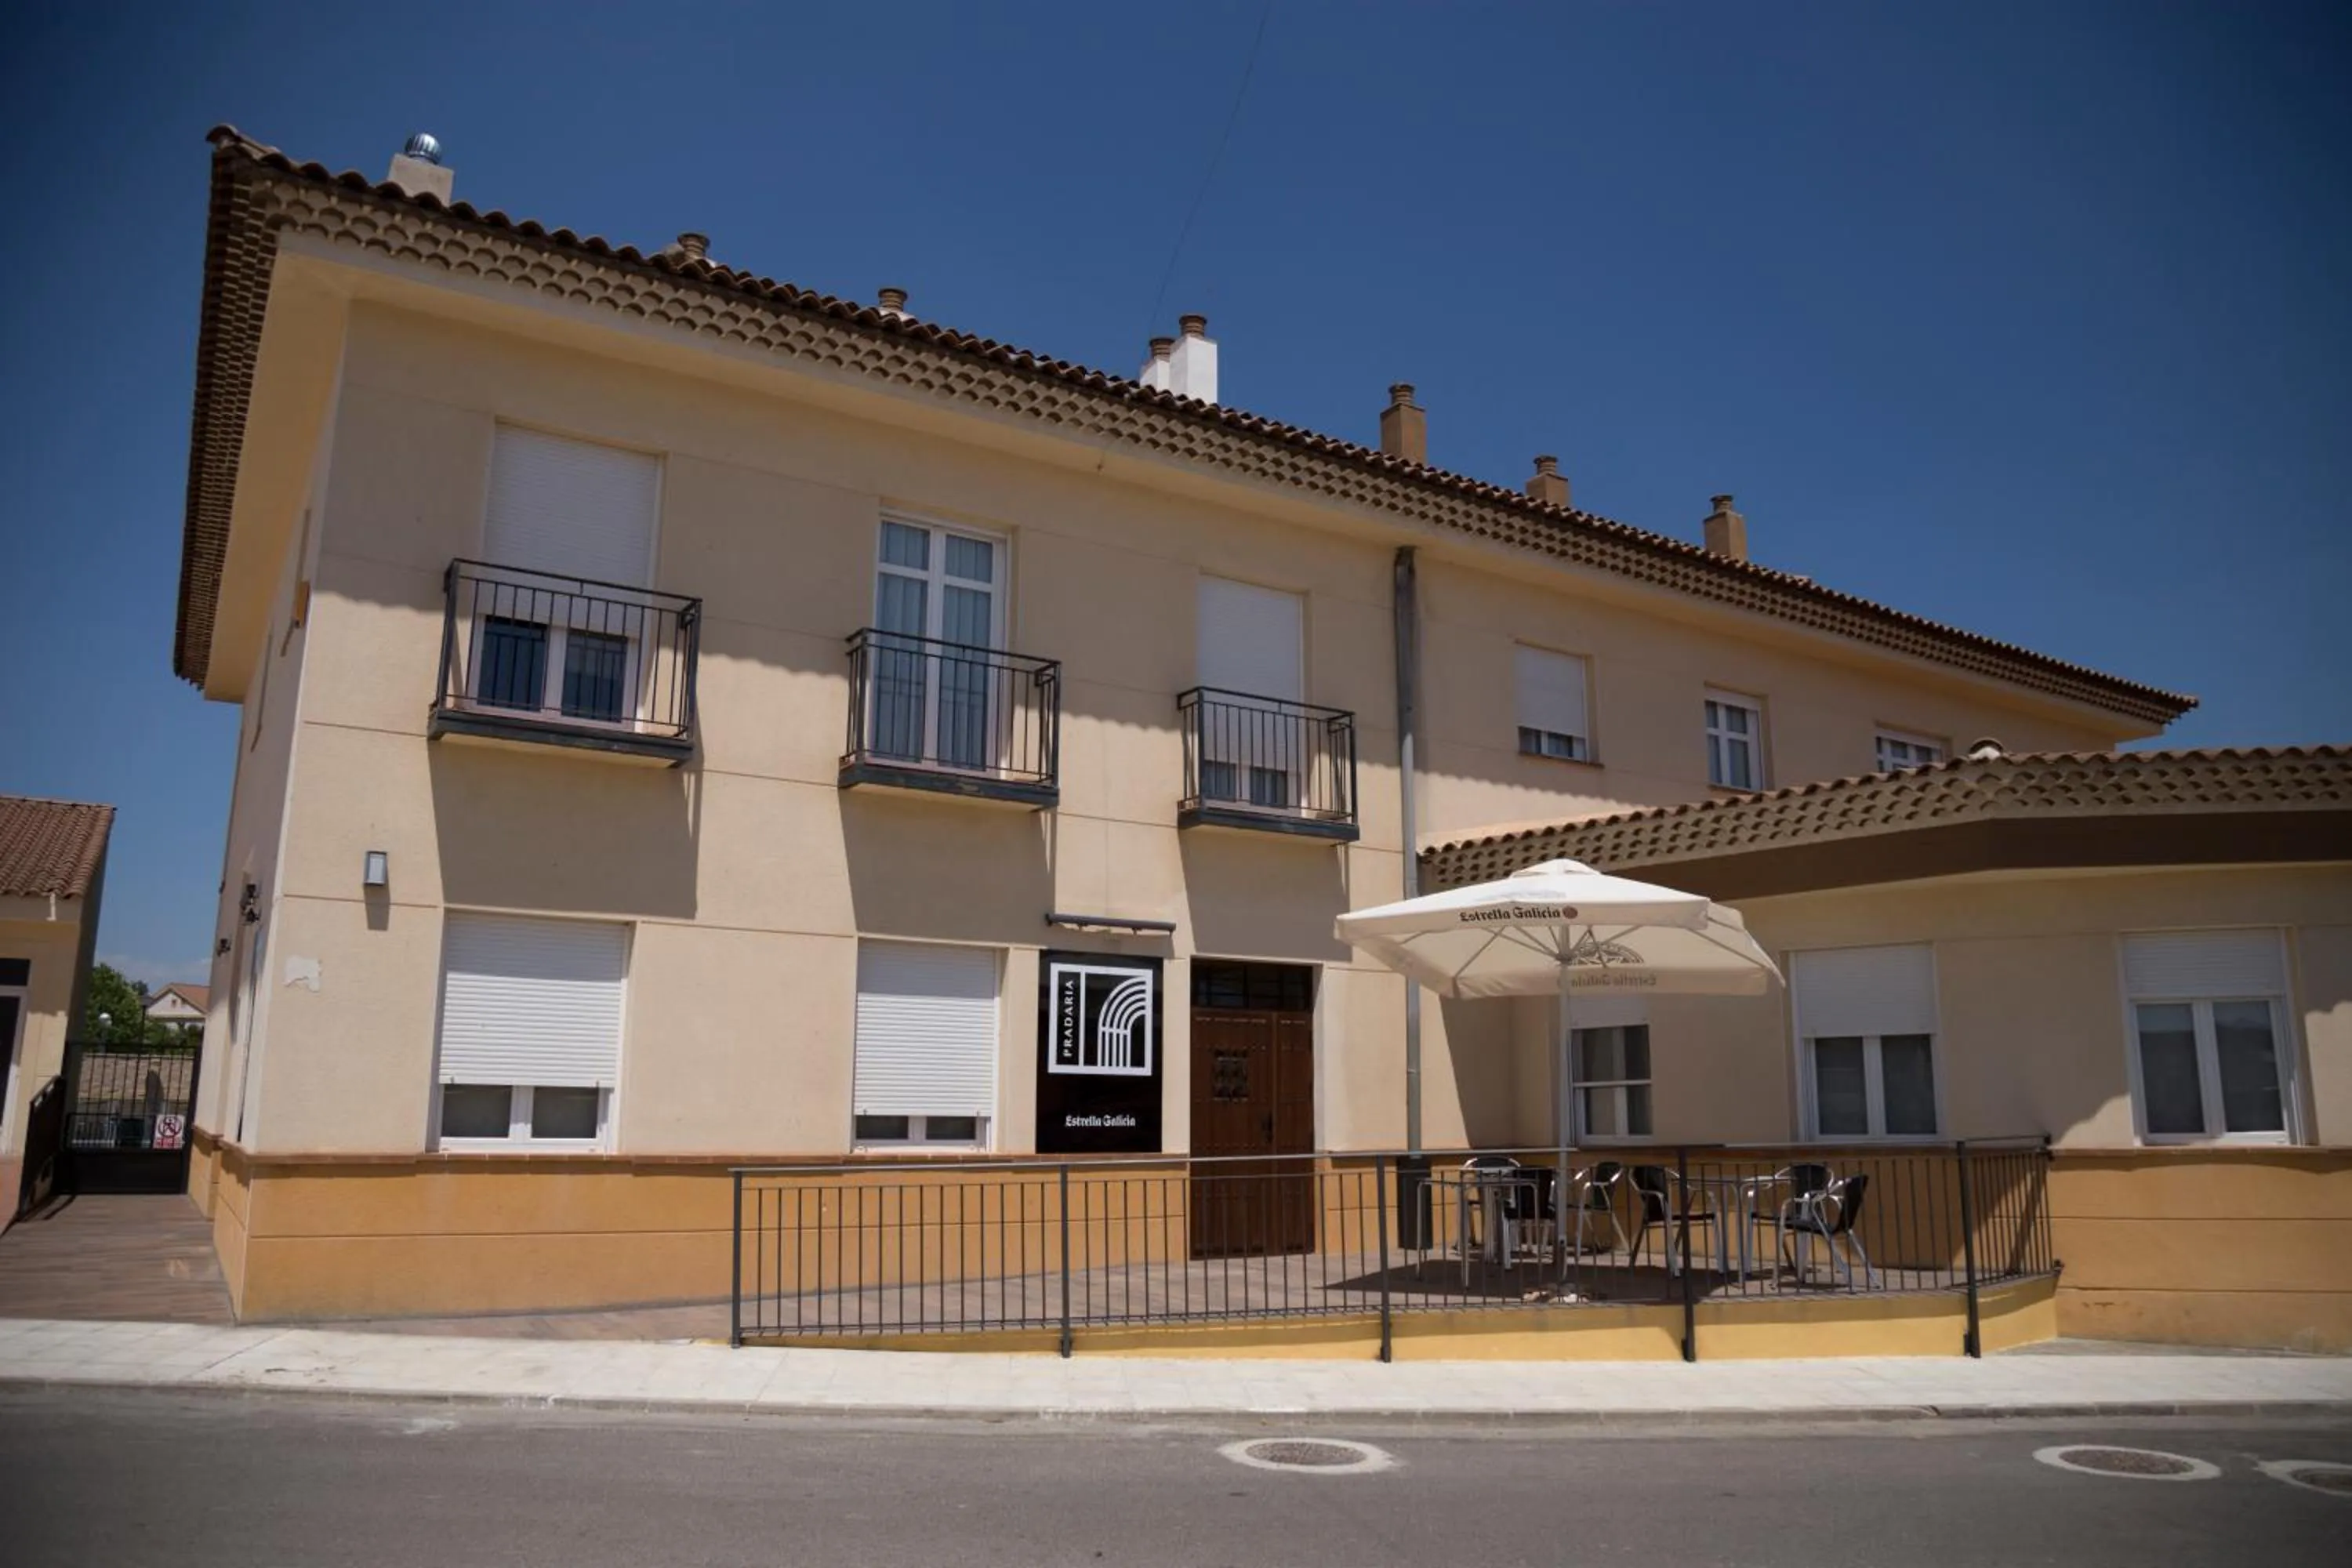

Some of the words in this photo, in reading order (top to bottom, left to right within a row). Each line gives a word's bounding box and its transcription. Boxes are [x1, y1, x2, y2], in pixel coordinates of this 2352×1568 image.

[1460, 907, 1511, 921] Estrella
[1512, 906, 1561, 919] Galicia
[1062, 980, 1073, 1057] PRADARIA
[1065, 1115, 1102, 1127] Estrella
[1102, 1114, 1136, 1127] Galicia
